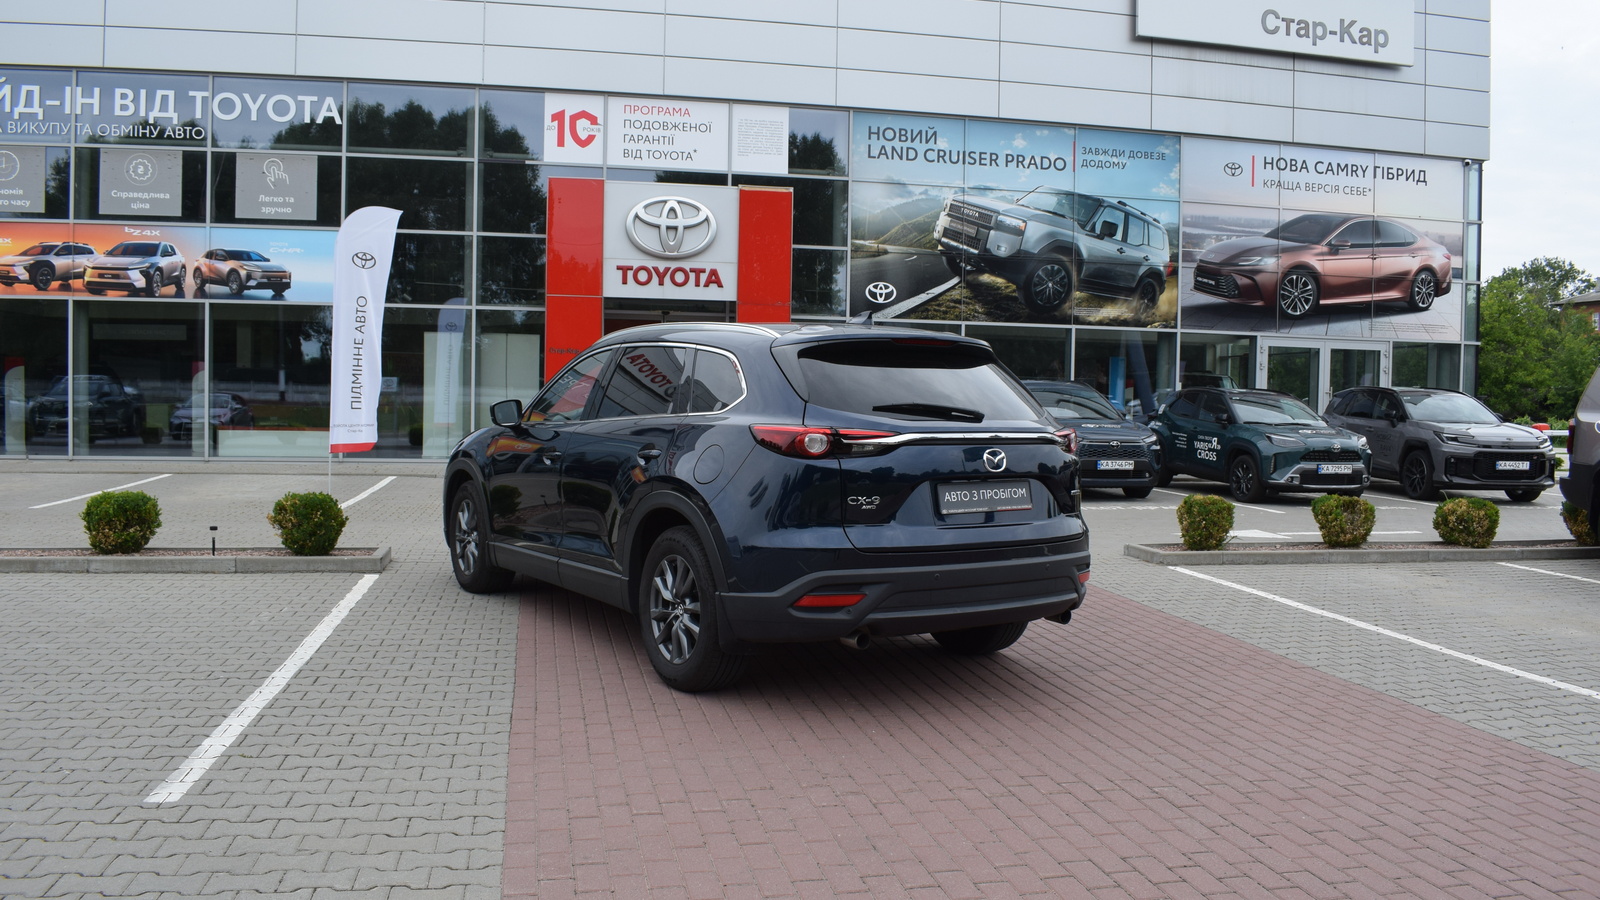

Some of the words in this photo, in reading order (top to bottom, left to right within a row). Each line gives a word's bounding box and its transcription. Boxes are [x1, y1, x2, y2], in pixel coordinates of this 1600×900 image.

[1260, 9, 1389, 53] Стар-Кар
[114, 88, 178, 124] ВІД
[188, 91, 342, 125] TOYOTA
[623, 104, 691, 117] ПРОГРАМА
[8, 121, 70, 134] ВИКУПУ
[75, 123, 93, 135] ТА
[97, 123, 158, 138] ОБМІНУ
[164, 126, 205, 139] АВТО
[623, 119, 712, 133] ПОДОВЖЕНОЇ
[623, 133, 674, 146] ГАРАНТІЇ
[868, 125, 938, 145] НОВИЙ
[623, 148, 643, 160] ВІД
[867, 145, 918, 162] LAND
[923, 148, 999, 167] CRUISER
[1005, 154, 1067, 172] PRADO
[1081, 146, 1125, 158] ЗАВЖДИ
[1128, 149, 1166, 161] ДОВЕЗЕ
[1081, 159, 1127, 170] ДОДОМУ
[1263, 156, 1309, 174] НОВА
[1314, 161, 1369, 178] CAMRY
[1373, 165, 1428, 186] ГІБРИД
[1263, 179, 1302, 192] КРАЩА
[1304, 182, 1340, 195] ВЕРСІЯ
[111, 190, 170, 201] Справедлива
[258, 195, 279, 204] Легко
[131, 202, 150, 210] ціна
[261, 206, 292, 215] зручно
[616, 265, 724, 288] TOYOTA
[355, 295, 368, 335] АВТО
[350, 338, 364, 410] ПІДМІННЕ
[1194, 441, 1208, 450] YARIS
[1197, 450, 1217, 461] CROSS
[847, 496, 880, 505] CX-9
[944, 490, 970, 502] АВТО
[980, 488, 1027, 500] ПРОБІГОМ
